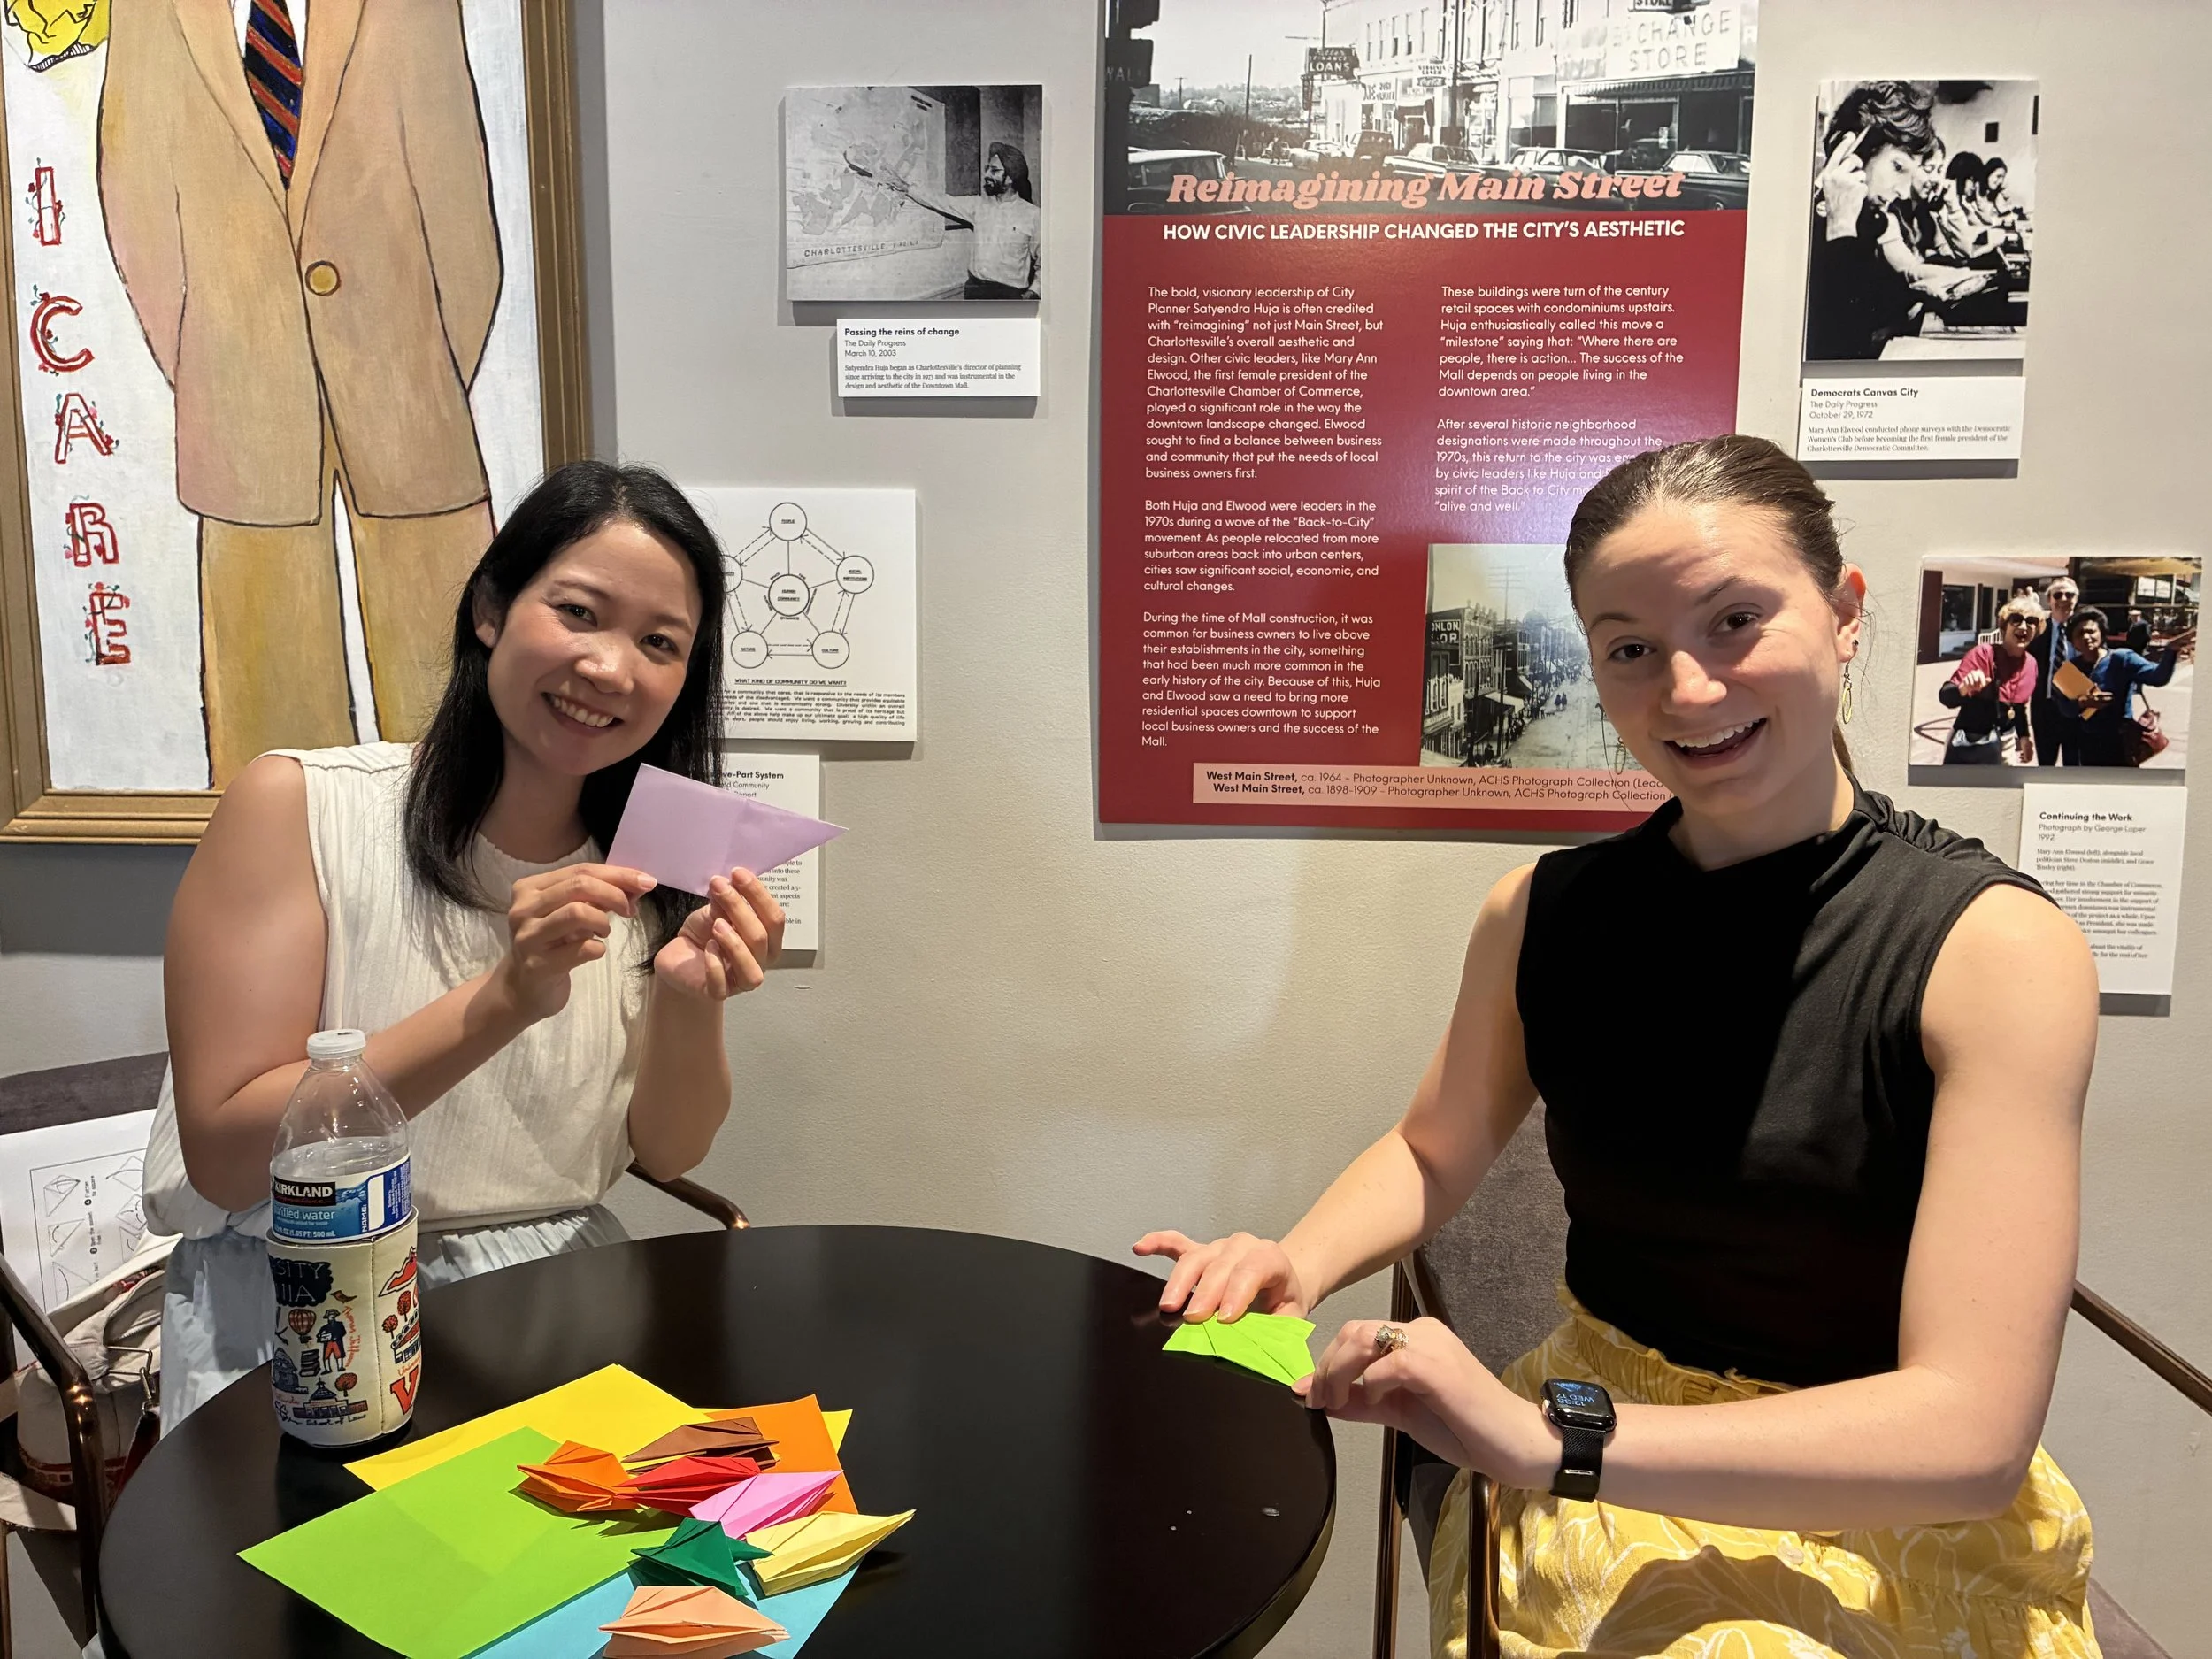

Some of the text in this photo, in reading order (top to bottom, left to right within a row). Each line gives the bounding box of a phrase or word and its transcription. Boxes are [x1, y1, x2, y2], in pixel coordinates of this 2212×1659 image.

[1629, 42, 1707, 71] STORE
[1310, 62, 1350, 72] LOANS
[1166, 171, 1681, 209] Reimagining Main Street
[34, 166, 63, 246] I
[1164, 224, 1210, 239] HOW
[1215, 224, 1265, 239] CIVIC
[1271, 224, 1379, 239] LEADERSHIP
[1384, 223, 1478, 238] CHANGED
[1483, 222, 1517, 238] THE
[1583, 219, 1685, 237] AESTHETIC
[804, 243, 886, 257] CHARLOTTESVILLE
[1148, 286, 1354, 299] The bold, visionary leadership of City
[1441, 286, 1474, 296] These
[1478, 285, 1528, 299] buildings
[1563, 286, 1585, 296] turn
[1588, 285, 1601, 296] of
[1603, 285, 1622, 296] the
[1625, 286, 1669, 297] century
[1148, 303, 1373, 316] Planner Satyendra Huja is often credited
[1441, 301, 1674, 316] retail spaces with condominiums upstairs.
[844, 327, 876, 337] Passing
[927, 327, 959, 337] change
[858, 339, 875, 348] Daily
[877, 339, 906, 348] Progress
[1900, 388, 1918, 397] City
[1824, 400, 1844, 409] Daily
[1846, 400, 1878, 409] Progress
[1843, 411, 1855, 419] 29,
[1437, 419, 1636, 433] After several historic neighborhood
[1144, 580, 1234, 593] cultural changes.
[755, 771, 784, 780] System
[1206, 771, 1232, 780] West
[1234, 771, 1261, 780] Main
[1263, 772, 1297, 782] Street,
[1319, 772, 1341, 781] 1964
[1353, 773, 1424, 786] Photographer
[1427, 774, 1475, 786] Unknown,
[1479, 775, 1509, 785] ACHS
[1512, 775, 1572, 788] Photograph
[1576, 776, 1630, 787] Collection
[733, 781, 770, 790] Community
[1213, 783, 1239, 792] West
[1242, 783, 1268, 792] Main
[1271, 784, 1304, 795] Street,
[1388, 786, 1459, 798] Photographer
[1463, 787, 1511, 799] Unknown,
[1514, 787, 1544, 797] ACHS
[1548, 788, 1609, 801] Photograph
[1612, 790, 1665, 800] Collection
[2039, 811, 2089, 823] Continuing
[2039, 823, 2081, 833] Photograph
[2093, 824, 2124, 833] George
[275, 1182, 334, 1198] KIRKLAND
[302, 1210, 335, 1220] water
[390, 1364, 419, 1415] V
